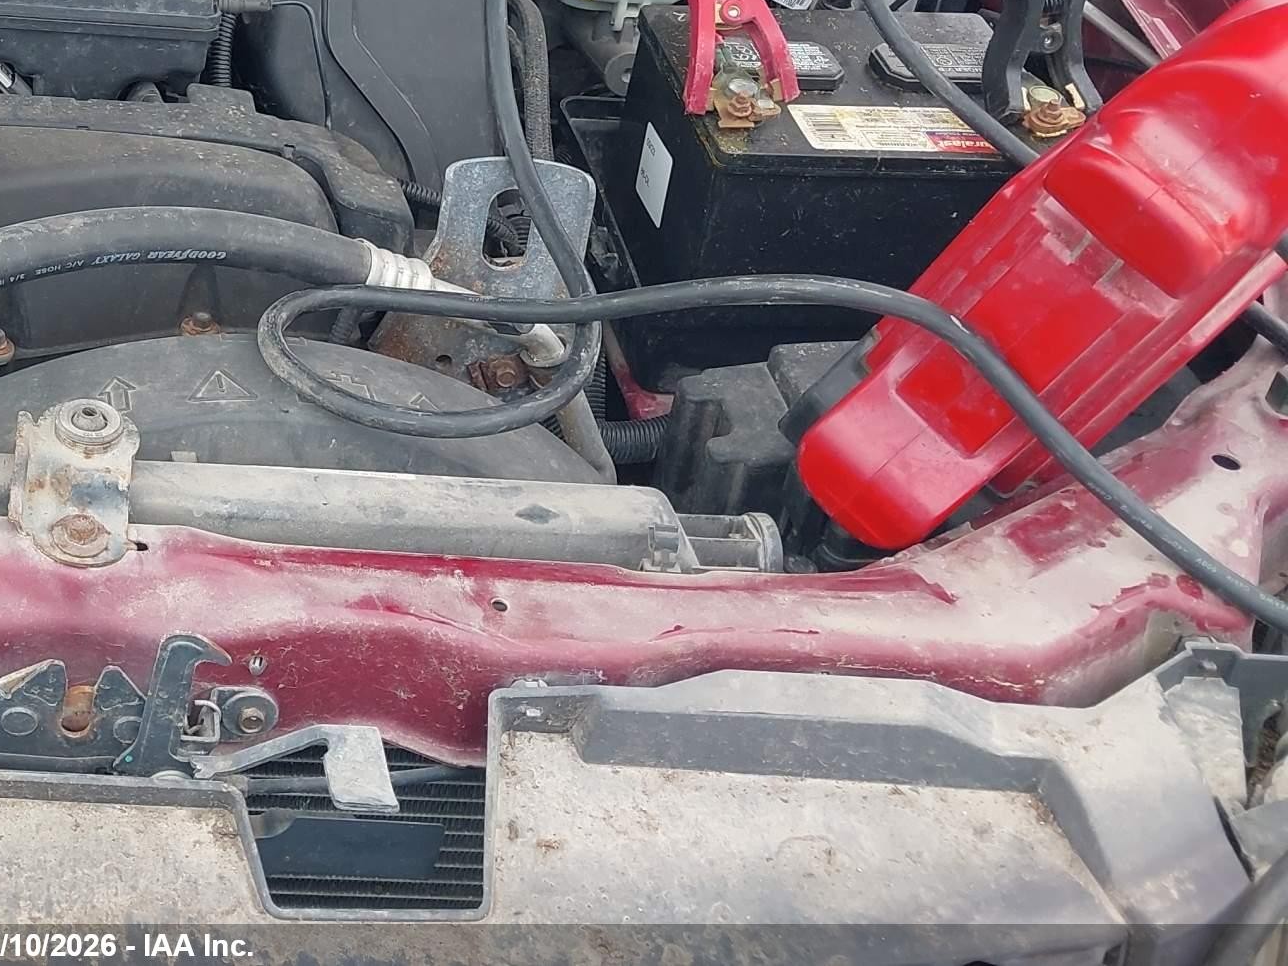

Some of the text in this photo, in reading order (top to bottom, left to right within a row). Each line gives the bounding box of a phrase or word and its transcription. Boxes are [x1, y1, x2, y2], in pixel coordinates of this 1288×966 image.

[936, 139, 992, 149] uralast
[91, 251, 142, 265] GALAXY
[147, 249, 227, 260] GOODYEAR
[33, 264, 62, 276] HOSE
[65, 259, 85, 270] A/C
[9, 272, 25, 284] 3/4
